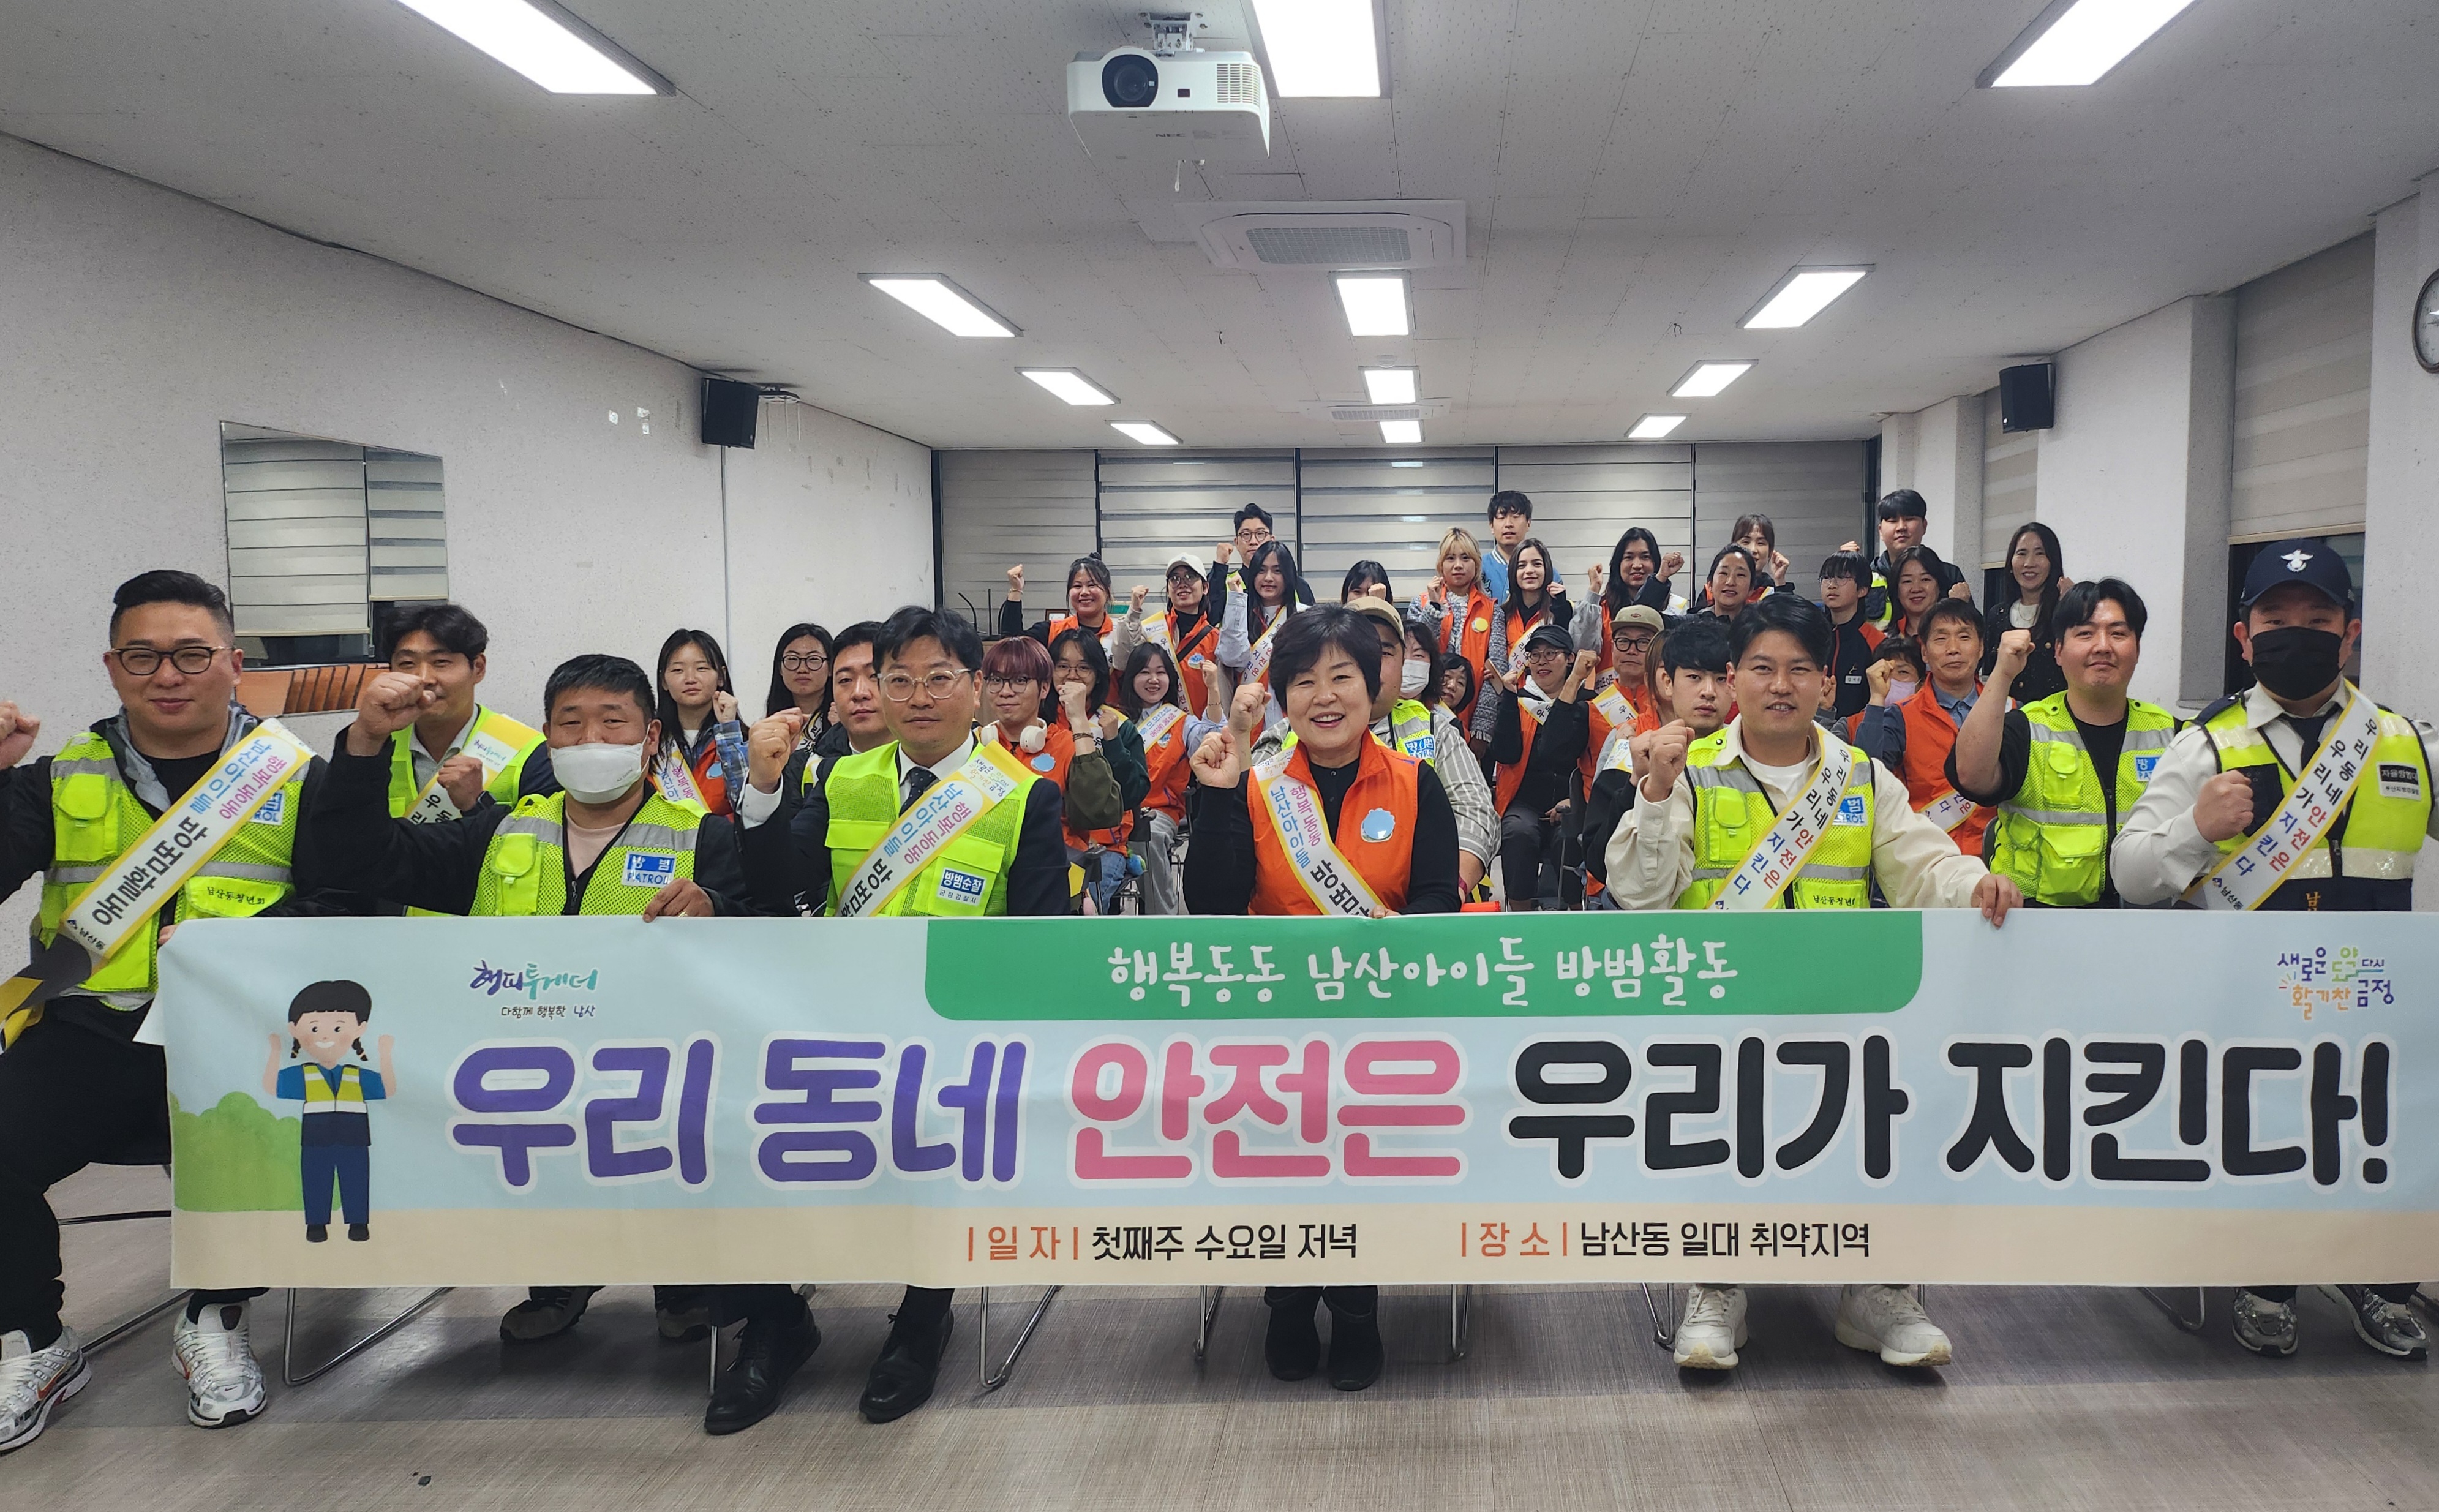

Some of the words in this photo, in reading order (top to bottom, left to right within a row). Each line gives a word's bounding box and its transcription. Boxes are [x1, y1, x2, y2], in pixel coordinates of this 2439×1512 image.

[190, 739, 272, 814] 남산아이들
[219, 756, 287, 819] 행복동동
[884, 783, 963, 857] 남산아이들
[904, 802, 972, 865] 행복동동
[1271, 786, 1311, 868] 남산아이들
[1290, 784, 1321, 846] 행복동동
[92, 816, 209, 925] 방범활동
[944, 871, 982, 893] 방범순찰
[1813, 895, 1855, 906] 남산동청년
[1107, 942, 1286, 1006] 행복동동
[1307, 937, 1535, 1006] 남산아이들
[1557, 934, 1738, 1005] 방범활동
[2277, 947, 2326, 982] 새로운
[2362, 958, 2385, 968] 다시
[501, 1005, 533, 1018] 다함께
[536, 1005, 566, 1020] 행복한
[574, 1004, 596, 1018] 남산
[2292, 984, 2351, 1021] 활기찬
[2357, 979, 2394, 1007] 금정
[452, 1038, 714, 1187] 우리
[753, 1039, 1023, 1184] 동네
[1067, 1039, 1466, 1178] 안전은
[1508, 1035, 1909, 1179] 우리가
[1946, 1037, 2391, 1186] 지킨다!
[1091, 1226, 1185, 1261] 첫째주
[1194, 1225, 1287, 1260] 수요일
[1297, 1223, 1357, 1259] 저녁
[1581, 1222, 1670, 1257] 남산동
[1680, 1222, 1740, 1257] 일대
[1750, 1222, 1870, 1257] 취약지역
